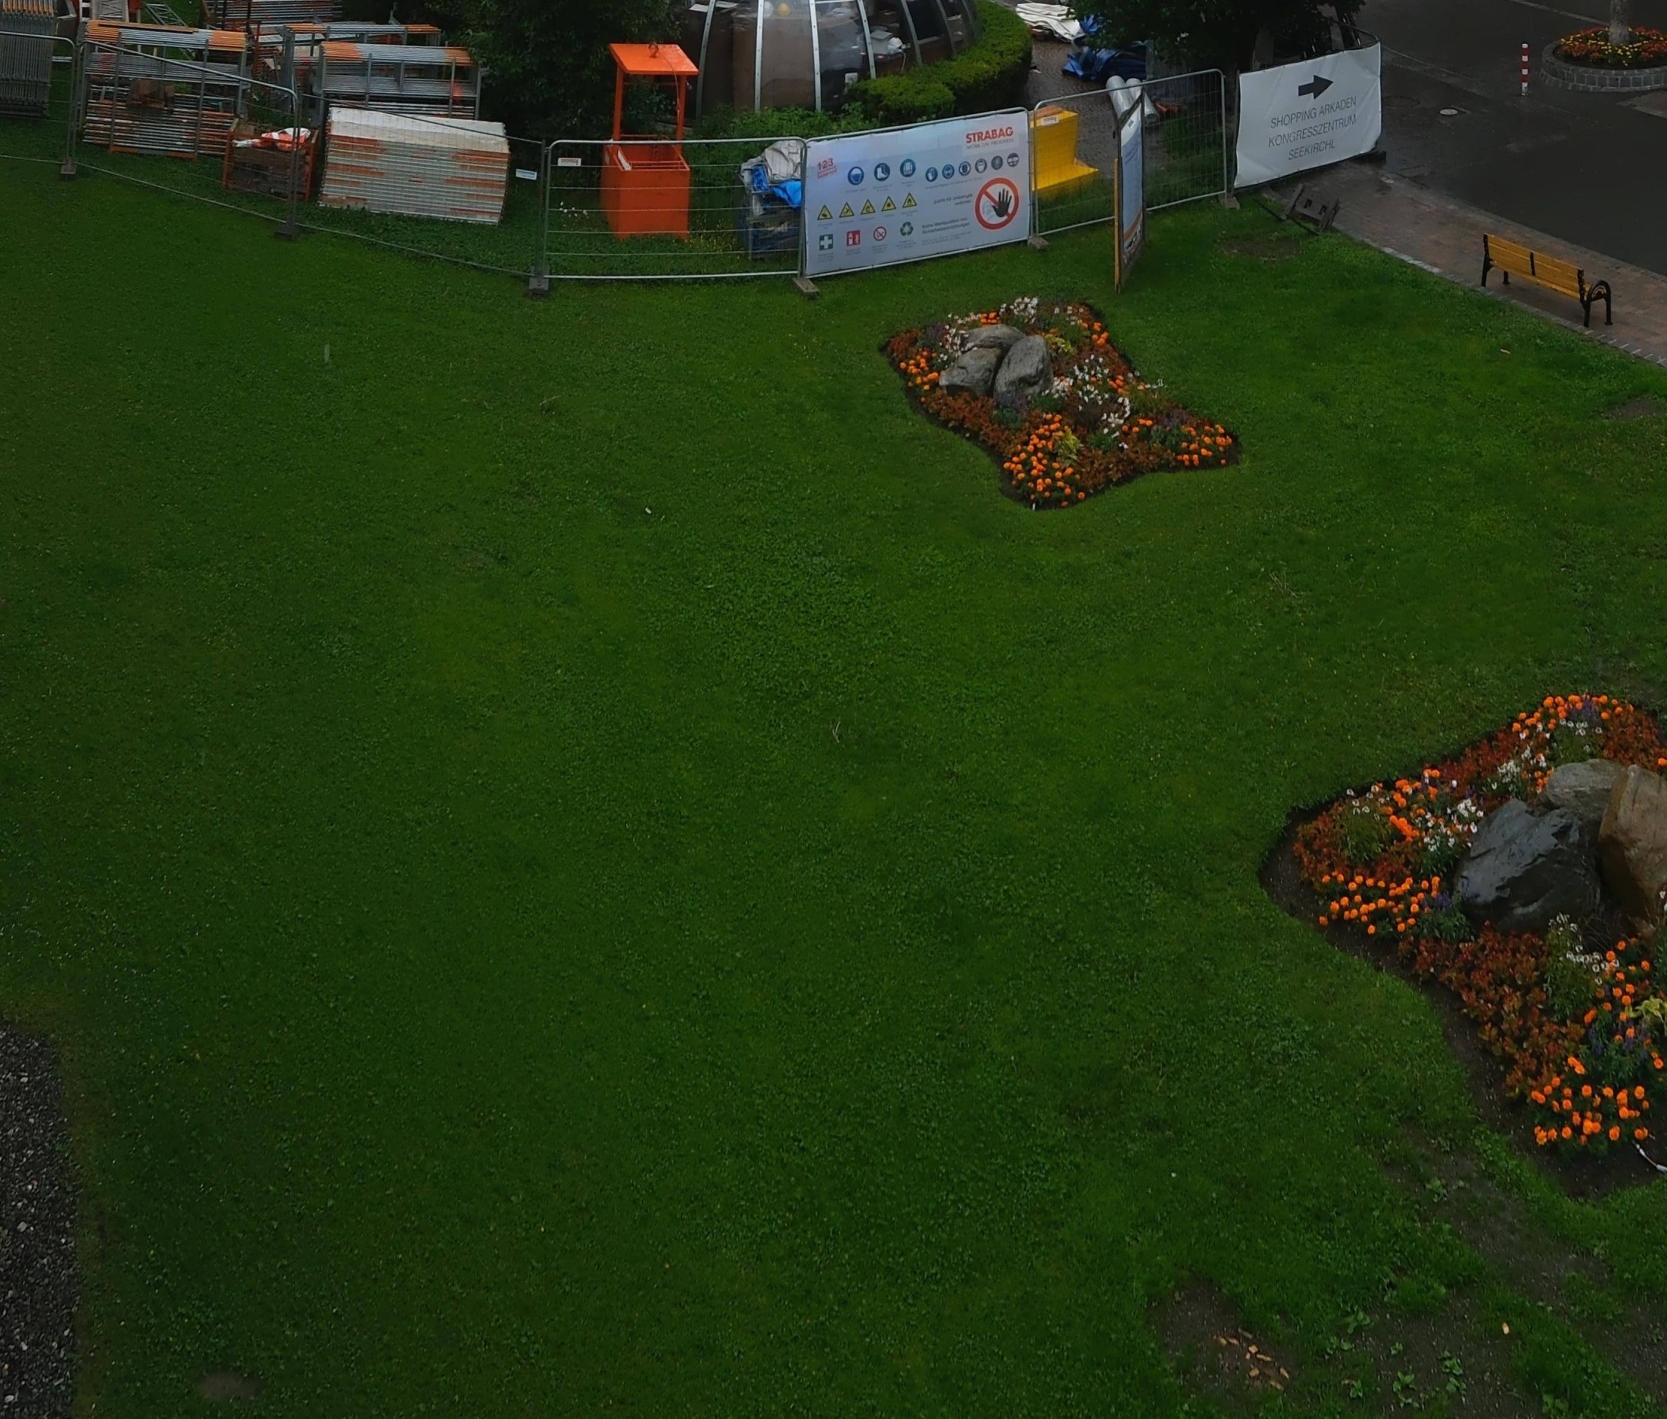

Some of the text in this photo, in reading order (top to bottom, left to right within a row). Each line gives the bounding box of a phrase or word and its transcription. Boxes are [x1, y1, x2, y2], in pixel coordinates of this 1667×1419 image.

[1270, 96, 1357, 129] SHOPPING ARKADEN
[965, 127, 1014, 143] STRABAG
[1268, 114, 1357, 148] KONGRESSZENTRUM
[1288, 139, 1336, 161] SEEKIRCHL
